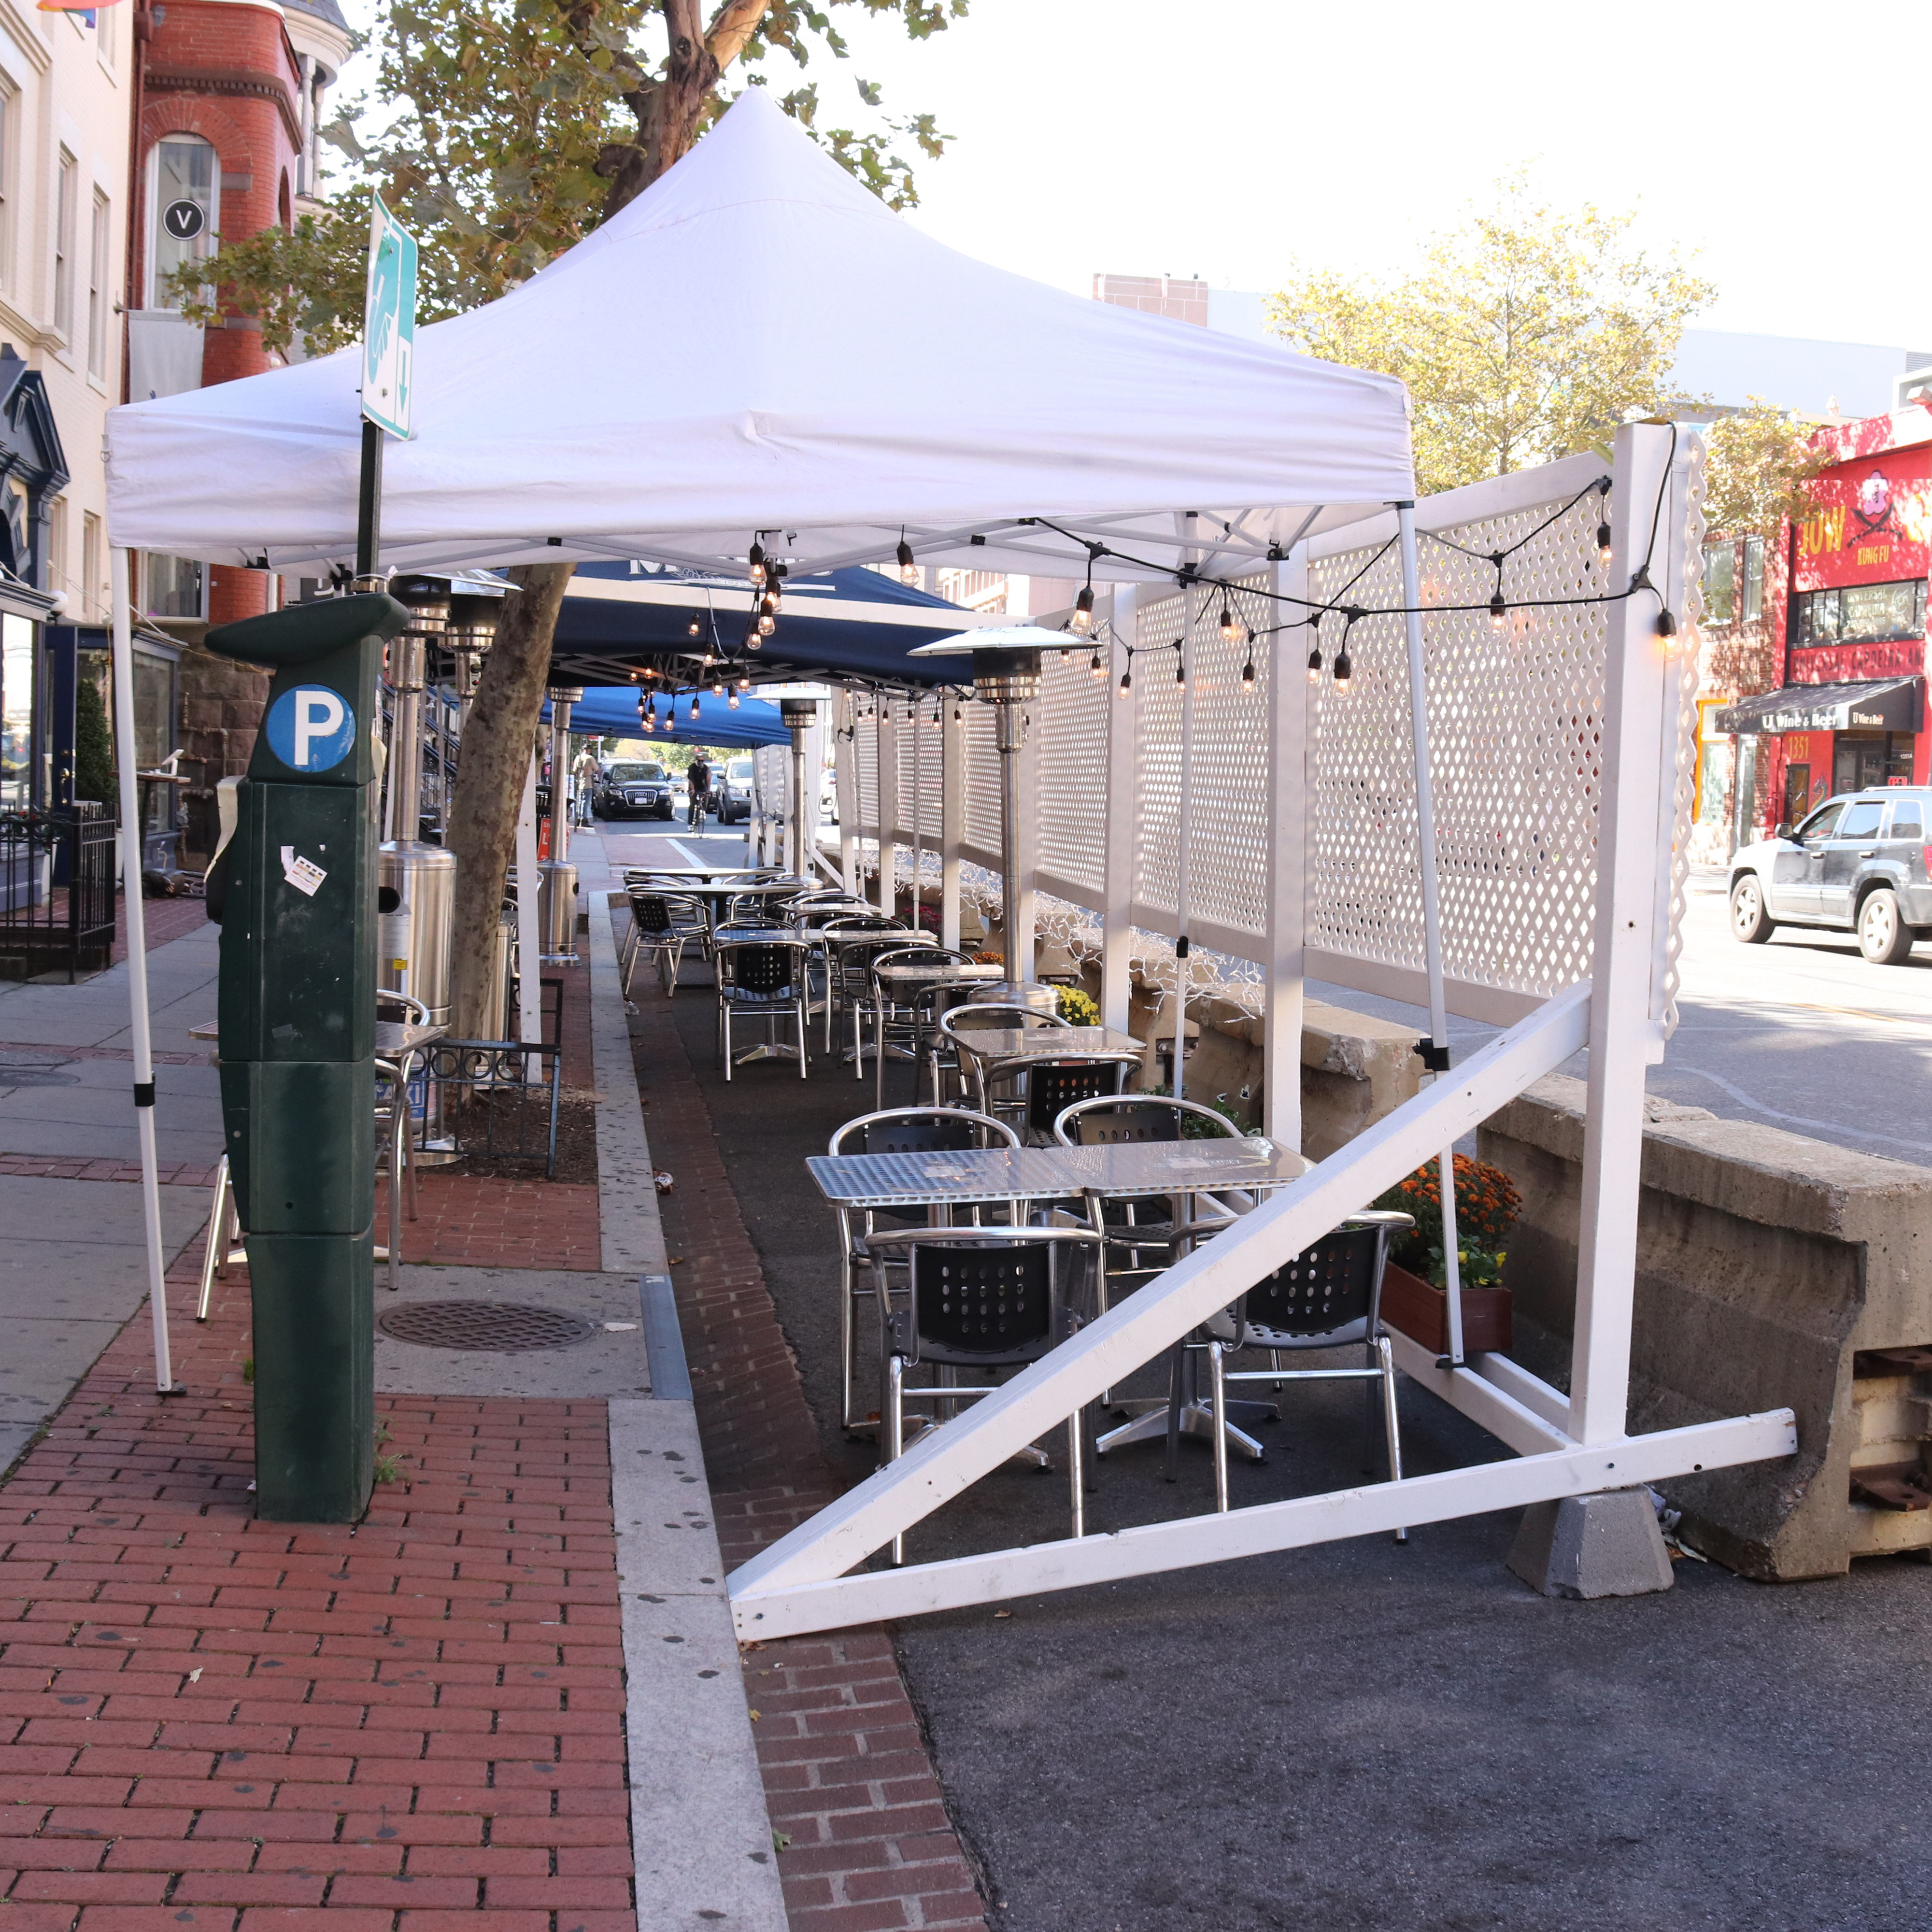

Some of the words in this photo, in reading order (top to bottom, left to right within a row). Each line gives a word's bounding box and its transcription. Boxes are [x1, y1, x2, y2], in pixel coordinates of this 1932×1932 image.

[176, 210, 192, 229] V
[1857, 546, 1878, 565] KUNG
[1878, 545, 1889, 564] FU
[1762, 715, 1774, 728] U
[1776, 715, 1801, 728] Wine
[1803, 716, 1810, 726] &
[1812, 713, 1838, 726] Beer
[1852, 712, 1858, 724] U
[1859, 713, 1869, 724] Wine
[1873, 714, 1884, 724] Beer
[295, 690, 344, 766] P
[1789, 736, 1809, 760] 1351
